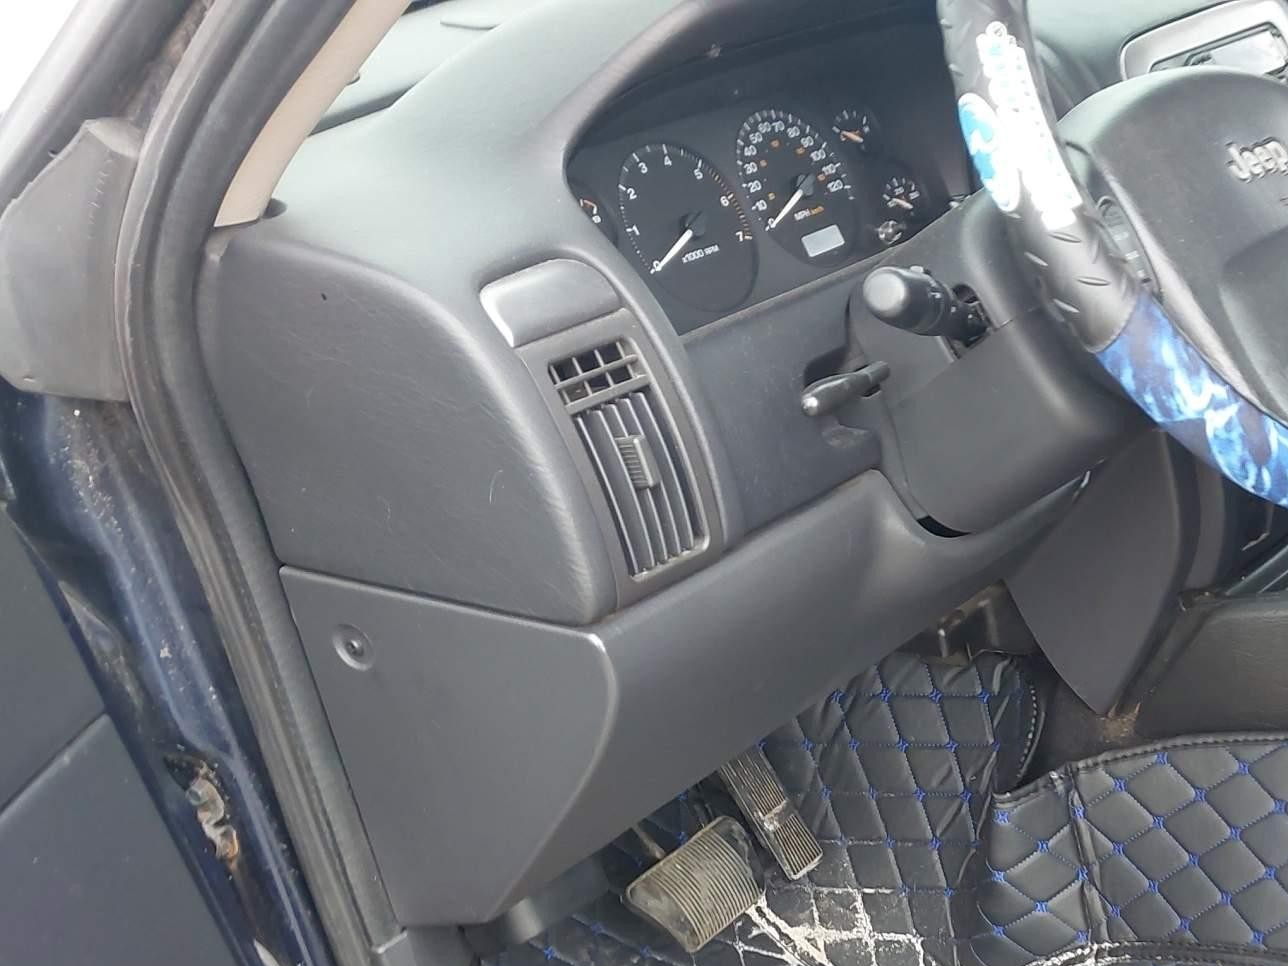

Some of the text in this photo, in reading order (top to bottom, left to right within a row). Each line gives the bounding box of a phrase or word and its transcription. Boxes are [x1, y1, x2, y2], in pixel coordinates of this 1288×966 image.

[772, 120, 785, 133] 70
[749, 131, 763, 144] 50
[663, 155, 673, 167] 4
[638, 162, 648, 174] 3
[693, 168, 704, 180] 5
[743, 161, 758, 175] 30
[747, 180, 762, 193] 20
[626, 187, 638, 200] 2
[720, 195, 730, 207] 6
[755, 199, 768, 212] 10
[735, 231, 744, 242] 7
